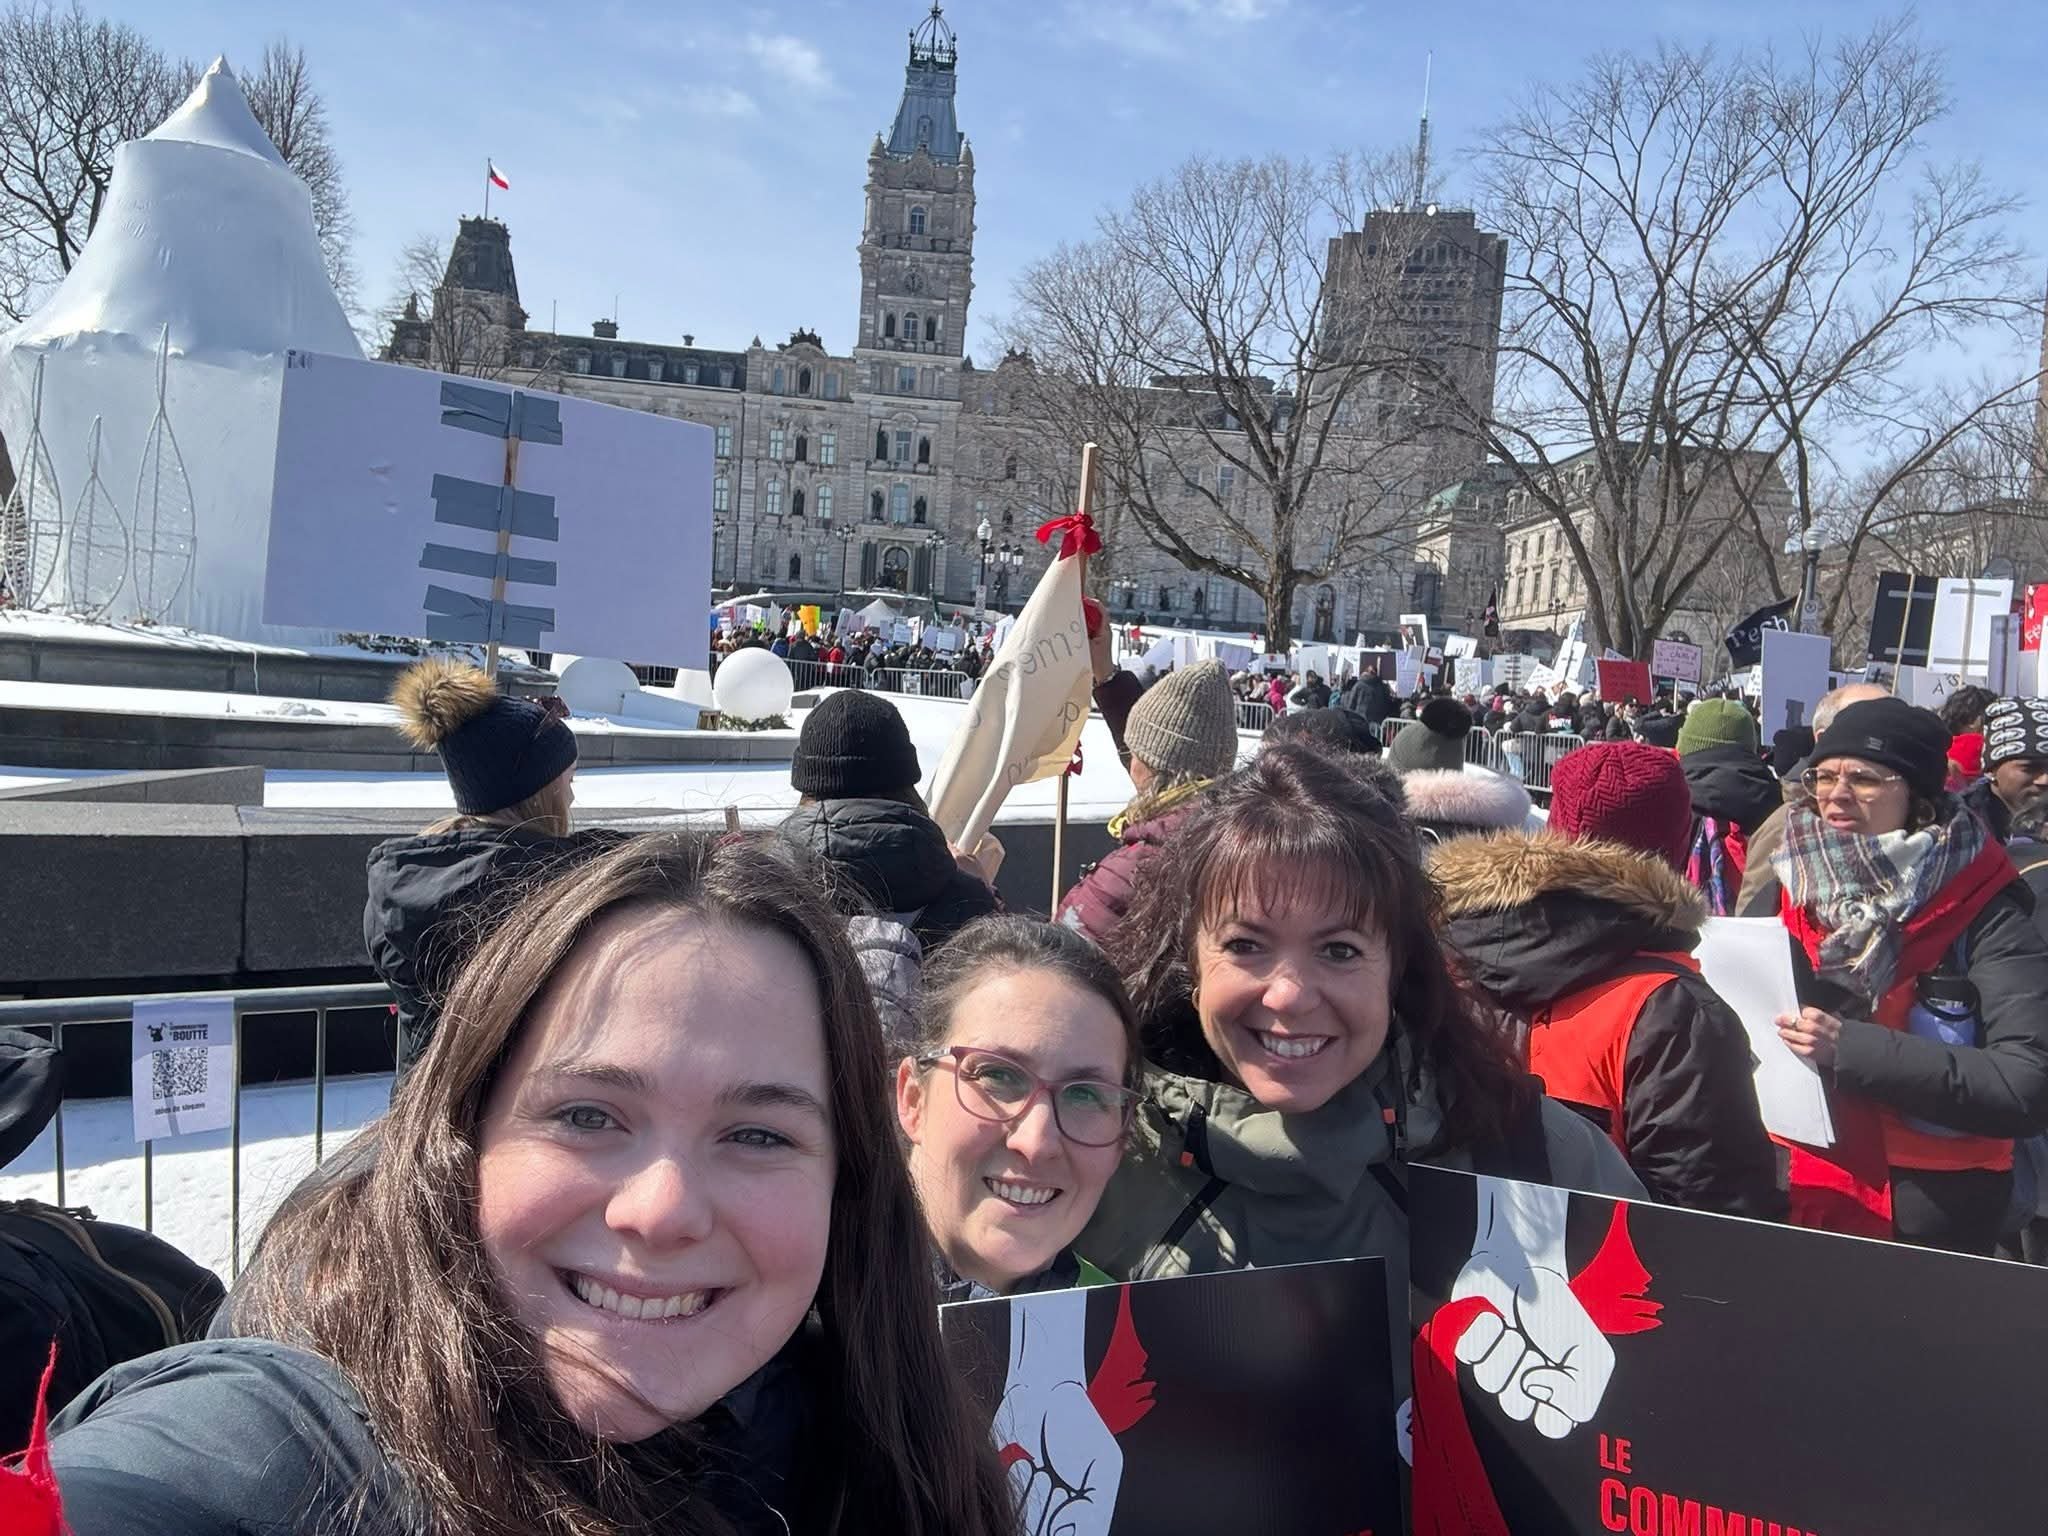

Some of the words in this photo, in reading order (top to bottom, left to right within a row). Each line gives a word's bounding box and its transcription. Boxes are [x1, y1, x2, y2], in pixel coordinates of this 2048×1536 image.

[172, 1029, 209, 1042] BOUTTE
[1599, 1433, 1632, 1475] LE
[1599, 1477, 1820, 1536] COMM
